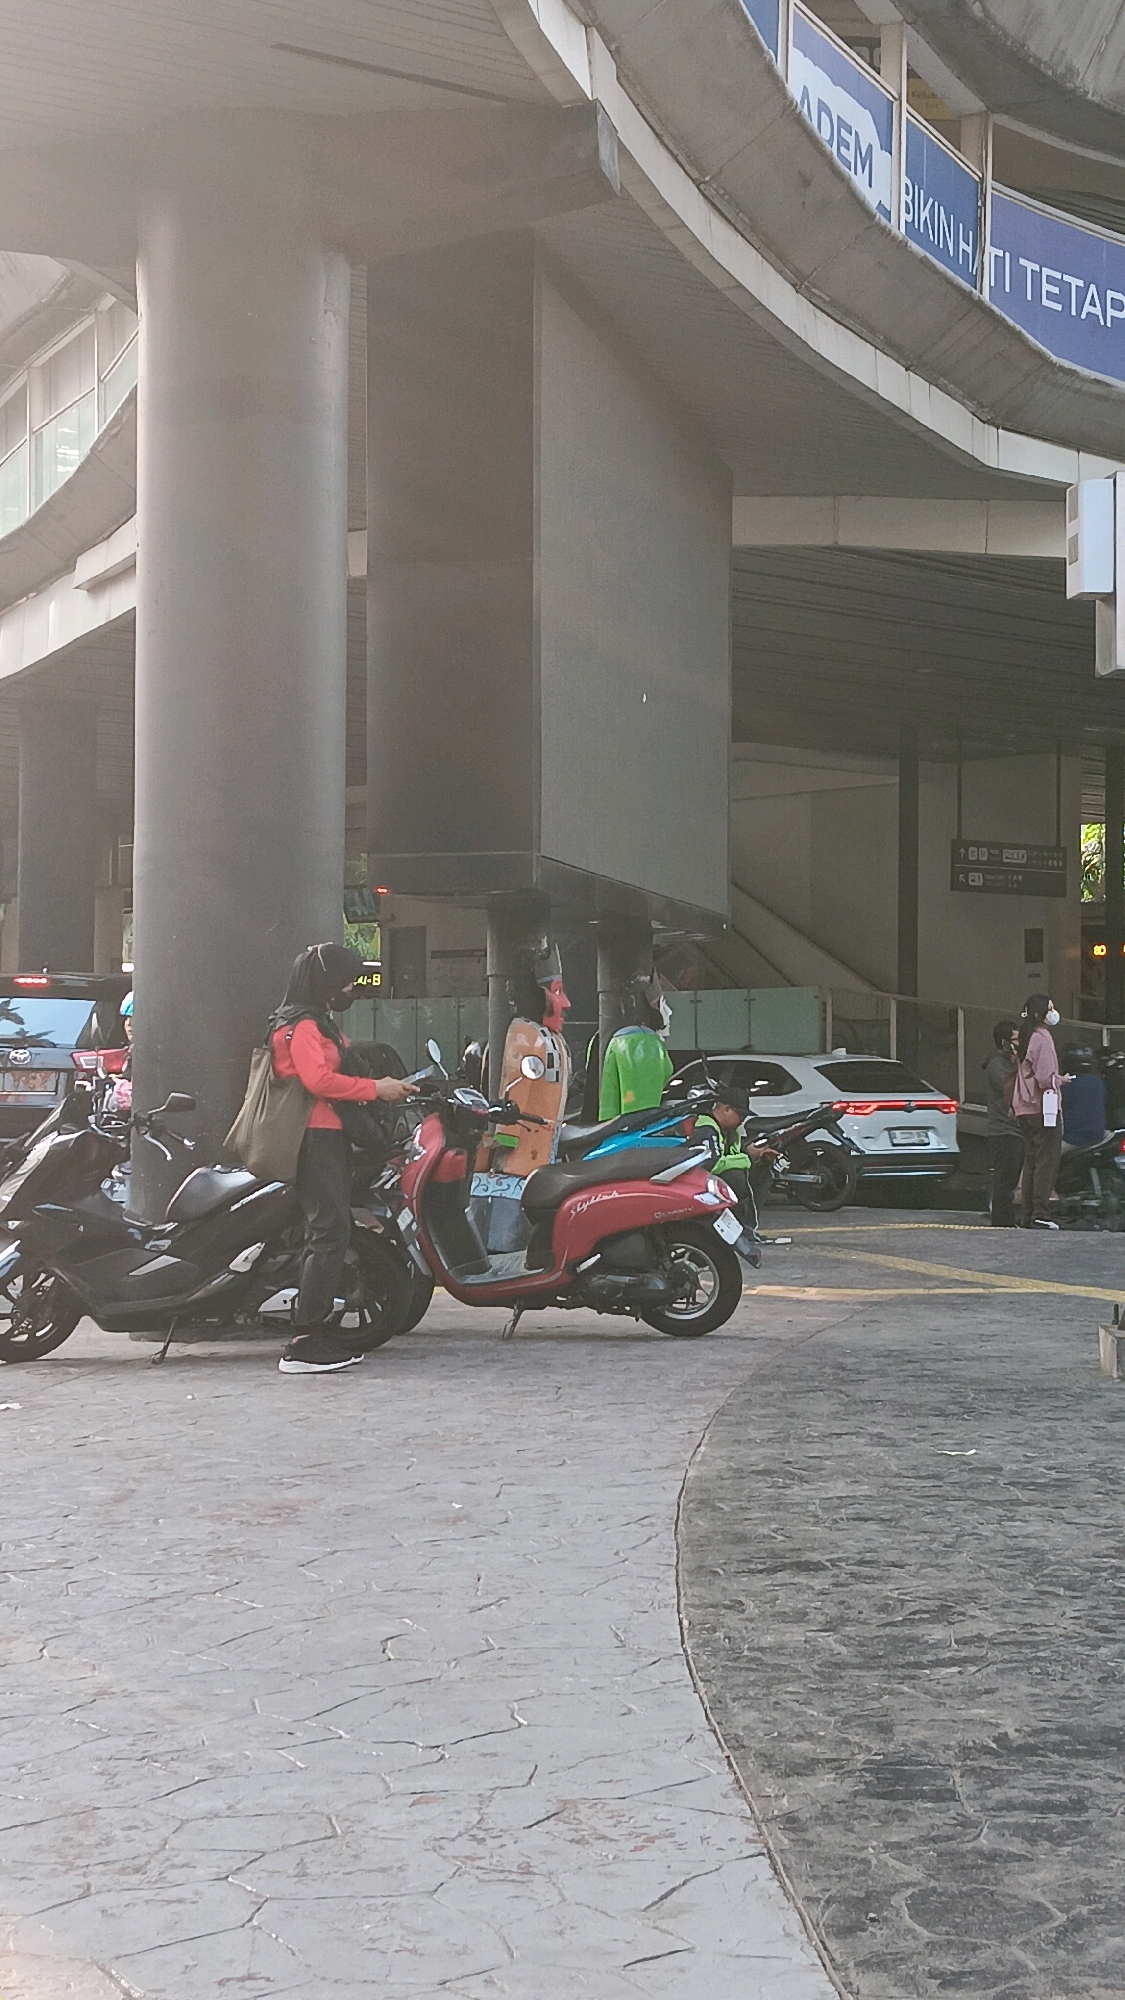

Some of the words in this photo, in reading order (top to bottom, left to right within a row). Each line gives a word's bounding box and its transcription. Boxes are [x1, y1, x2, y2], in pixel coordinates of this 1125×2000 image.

[799, 84, 873, 189] ADEM
[904, 175, 954, 258] BIKIN
[959, 222, 1010, 293] HTI
[1018, 256, 1125, 328] TETAP
